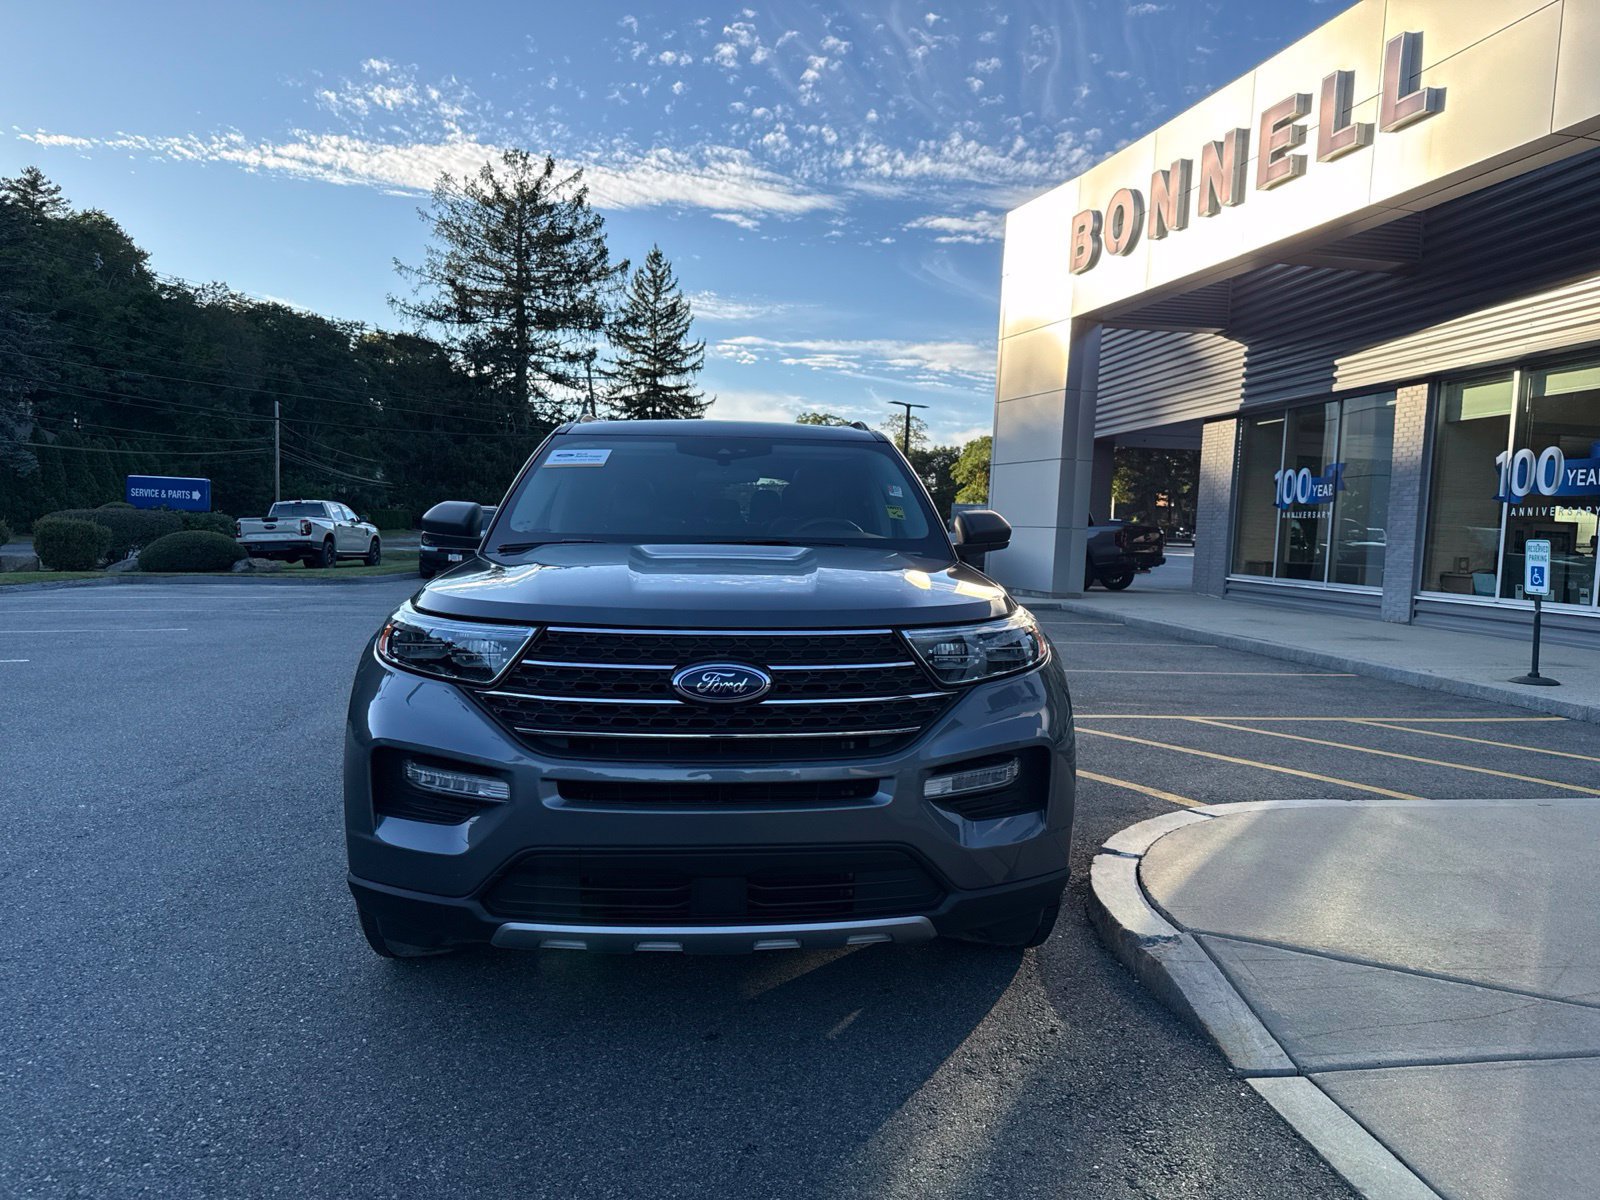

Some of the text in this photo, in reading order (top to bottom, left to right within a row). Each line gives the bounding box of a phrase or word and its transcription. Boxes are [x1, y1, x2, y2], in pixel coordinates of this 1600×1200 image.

[1069, 31, 1447, 275] BONNELL
[1495, 446, 1600, 497] 100 YEA
[1274, 467, 1312, 505] 100
[131, 488, 190, 499] SERVICE & PARTS
[1281, 511, 1331, 519] ANNIVERSARY
[1510, 504, 1600, 517] ANNIVERSARY
[1528, 545, 1548, 553] RESERVED
[1528, 554, 1548, 562] PARKING
[696, 671, 748, 693] Ford
